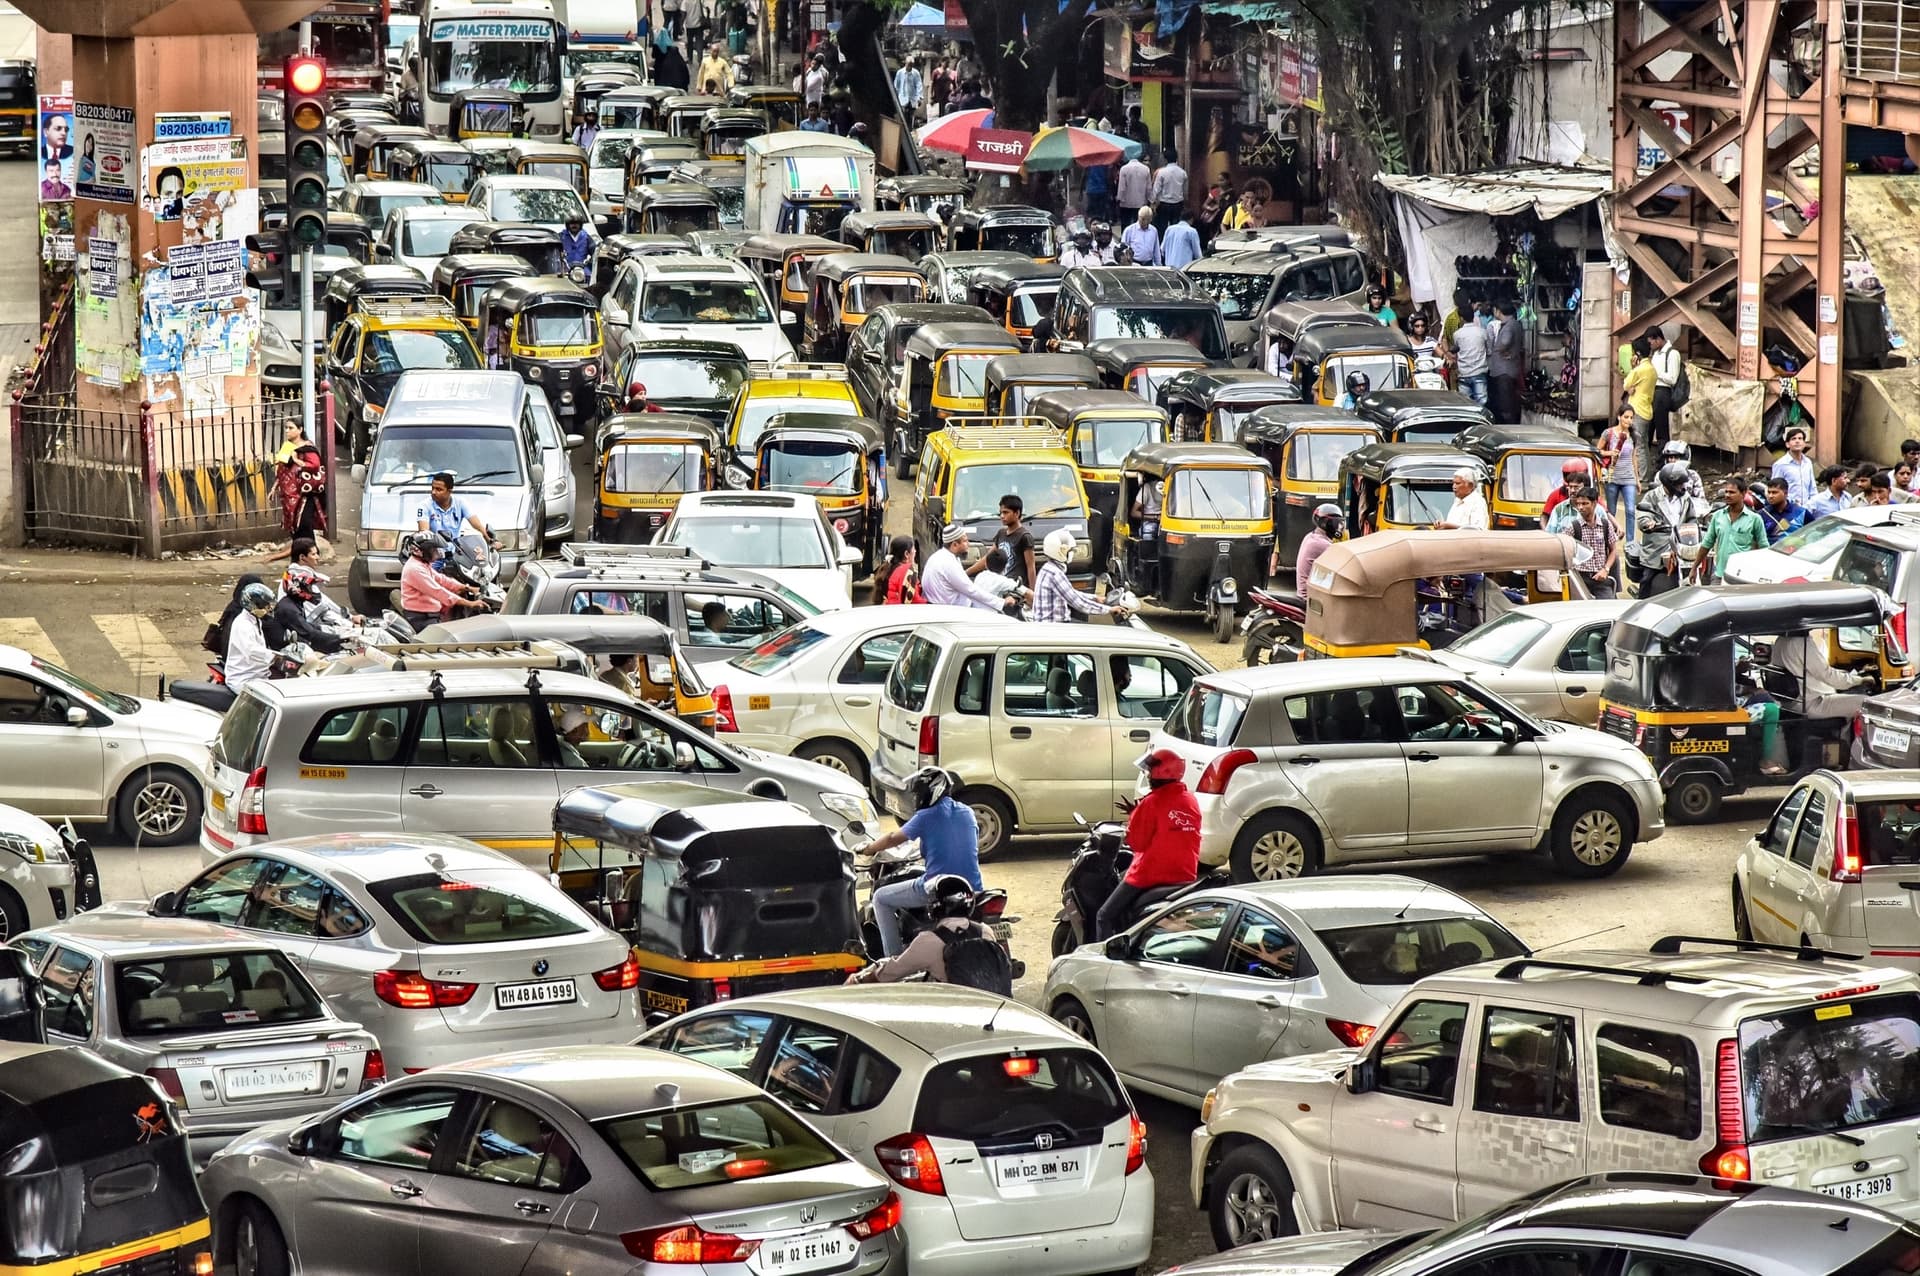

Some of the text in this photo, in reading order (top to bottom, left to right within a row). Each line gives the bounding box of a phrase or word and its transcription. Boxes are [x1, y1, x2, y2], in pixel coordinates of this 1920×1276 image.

[456, 24, 504, 36] MASTER
[504, 23, 551, 36] TRAVELS
[76, 104, 133, 121] 9820360417
[160, 122, 228, 136] 9820360417
[976, 140, 1024, 155] राजश्री
[1238, 154, 1277, 167] MAX
[301, 768, 309, 777] MH
[501, 984, 572, 1004] MH 48 AG 1999
[253, 1073, 266, 1086] 02
[270, 1072, 285, 1085] PA
[288, 1069, 315, 1082] 6765
[1004, 1161, 1080, 1179] MH 02 BM 871
[771, 1240, 841, 1265] MH 02 EE 1467
